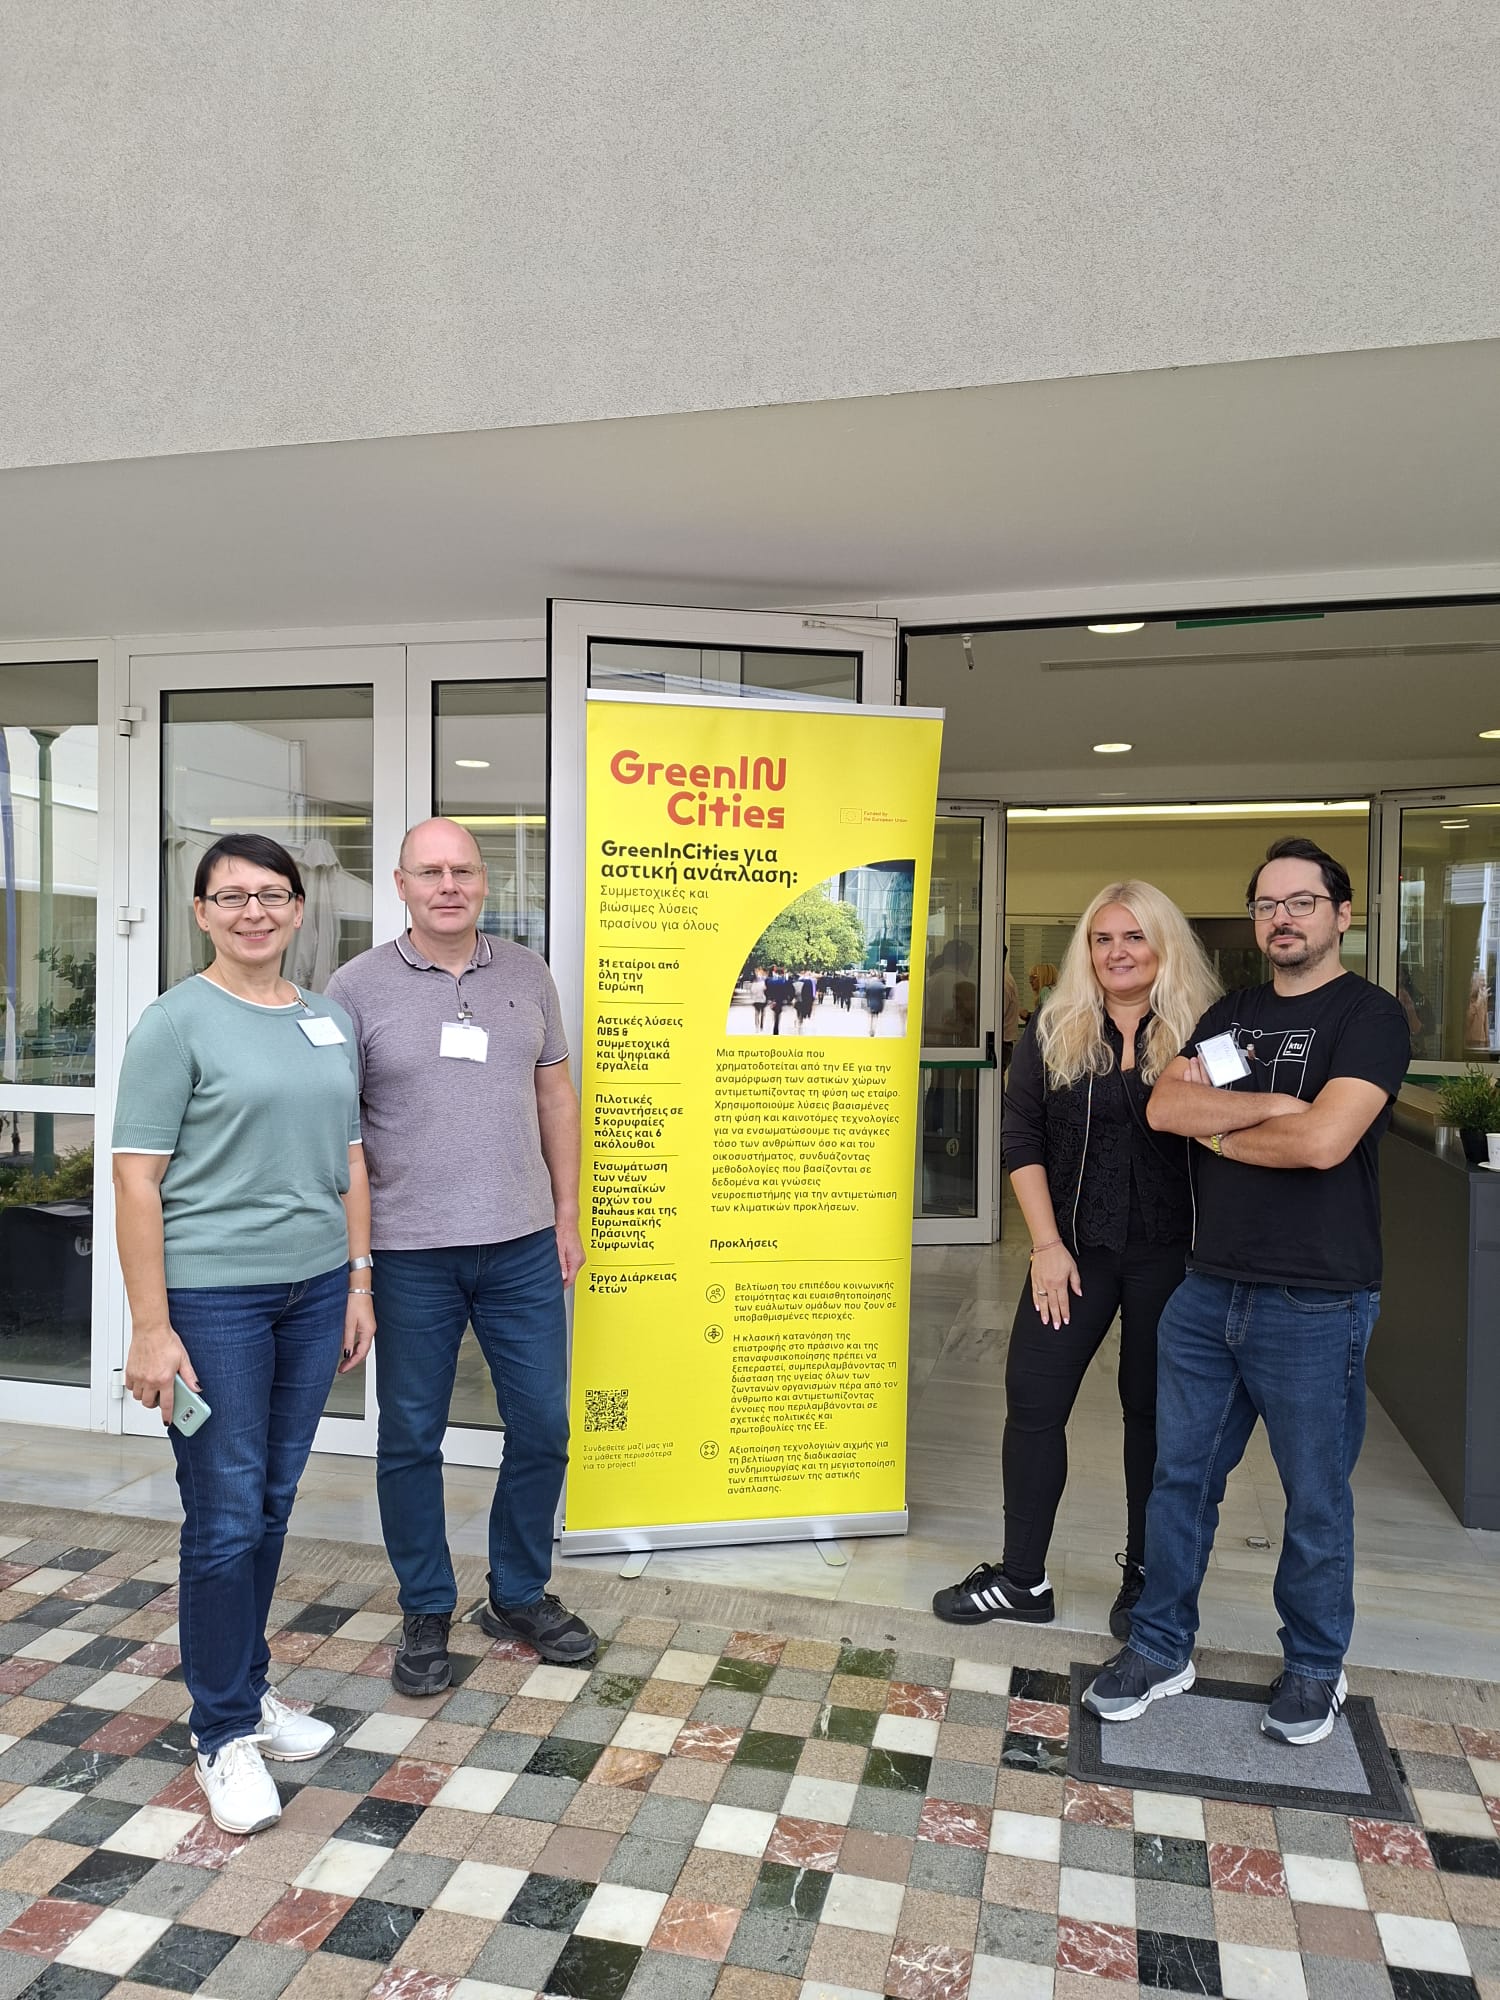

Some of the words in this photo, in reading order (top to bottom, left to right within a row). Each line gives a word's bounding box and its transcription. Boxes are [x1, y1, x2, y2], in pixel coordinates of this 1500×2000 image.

[610, 749, 787, 791] GreenIN
[667, 791, 785, 829] Cities
[601, 840, 739, 861] GreenInCities
[744, 849, 778, 865] για
[601, 861, 677, 884] αστική
[683, 862, 798, 887] ανάπλαση:
[600, 883, 686, 900] Συμμετοχικές
[689, 890, 708, 899] και
[600, 901, 655, 915] βιώσιμες
[659, 903, 698, 916] λύσεις
[600, 918, 657, 930] πρασίνου
[661, 921, 679, 932] για
[683, 919, 719, 933] όλους
[599, 958, 609, 967] 31
[612, 959, 656, 971] εταίροι
[658, 960, 679, 969] από
[598, 969, 619, 982] όλη
[622, 972, 643, 982] την
[598, 980, 644, 994] Ευρώπη
[597, 1015, 643, 1027] Αστικές
[645, 1016, 683, 1028] λύσεις
[597, 1027, 619, 1036] NBS
[597, 1038, 670, 1050] συμμετοχικά
[1288, 1042, 1303, 1050] ktu
[597, 1051, 615, 1059] και
[618, 1048, 670, 1061] ψηφιακά
[716, 1048, 735, 1057] Μια
[738, 1049, 803, 1059] πρωτοβουλία
[596, 1060, 648, 1072] εργαλεία
[716, 1061, 798, 1072] χρηματοδοτείται
[800, 1062, 820, 1071] από
[823, 1064, 840, 1073] την
[858, 1065, 872, 1073] για
[875, 1065, 891, 1074] την
[715, 1074, 782, 1085] αναμόρφωση
[807, 1075, 849, 1084] αστικών
[852, 1075, 886, 1086] χώρων
[715, 1087, 806, 1098] αντιμετωπίζοντας
[808, 1089, 819, 1098] τη
[822, 1088, 848, 1099] φύση
[851, 1090, 865, 1098] ως
[867, 1089, 900, 1099] εταίρο.
[596, 1094, 652, 1106] Πιλοτικές
[714, 1100, 794, 1111] Χρησιμοποιούμε
[797, 1100, 830, 1110] λύσεις
[832, 1101, 889, 1111] βασισμένες
[595, 1105, 668, 1117] συναντήσεις
[670, 1107, 683, 1115] σε
[594, 1116, 600, 1125] 5
[603, 1116, 664, 1128] κορυφαίες
[714, 1115, 732, 1124] στη
[734, 1113, 761, 1124] φύση
[782, 1114, 838, 1124] καινοτόμες
[841, 1114, 899, 1124] τεχνολογίες
[594, 1127, 632, 1139] πόλεις
[656, 1129, 662, 1137] 6
[594, 1138, 655, 1149] ακόλουθοι
[712, 1152, 797, 1162] οικοσυστήματος,
[799, 1151, 870, 1162] συνδυάζοντας
[594, 1161, 667, 1173] Ενσωμάτωση
[712, 1164, 779, 1175] μεθοδολογίες
[803, 1164, 857, 1174] βασίζονται
[593, 1174, 615, 1182] των
[617, 1171, 647, 1182] νέων
[711, 1177, 760, 1188] δεδομένα
[781, 1177, 821, 1187] γνώσεις
[592, 1183, 666, 1195] ευρωπαϊκών
[711, 1191, 791, 1200] νευροεπιστήμης
[794, 1191, 808, 1200] για
[811, 1191, 828, 1200] την
[831, 1190, 897, 1200] αντιμετώπιση
[592, 1194, 630, 1206] αρχών
[592, 1205, 635, 1215] Bauhaus
[658, 1207, 677, 1217] της
[733, 1202, 790, 1213] κλιματικών
[793, 1202, 859, 1212] προκλήσεων.
[592, 1216, 661, 1229] Ευρωπαϊκής
[591, 1227, 646, 1240] Πράσινης
[590, 1238, 654, 1251] Συμφωνίας
[710, 1238, 778, 1250] Προκλήσεις
[589, 1272, 617, 1284] Έργο
[620, 1272, 677, 1283] Διάρκειας
[589, 1284, 596, 1293] 4
[597, 1283, 627, 1293] ετών
